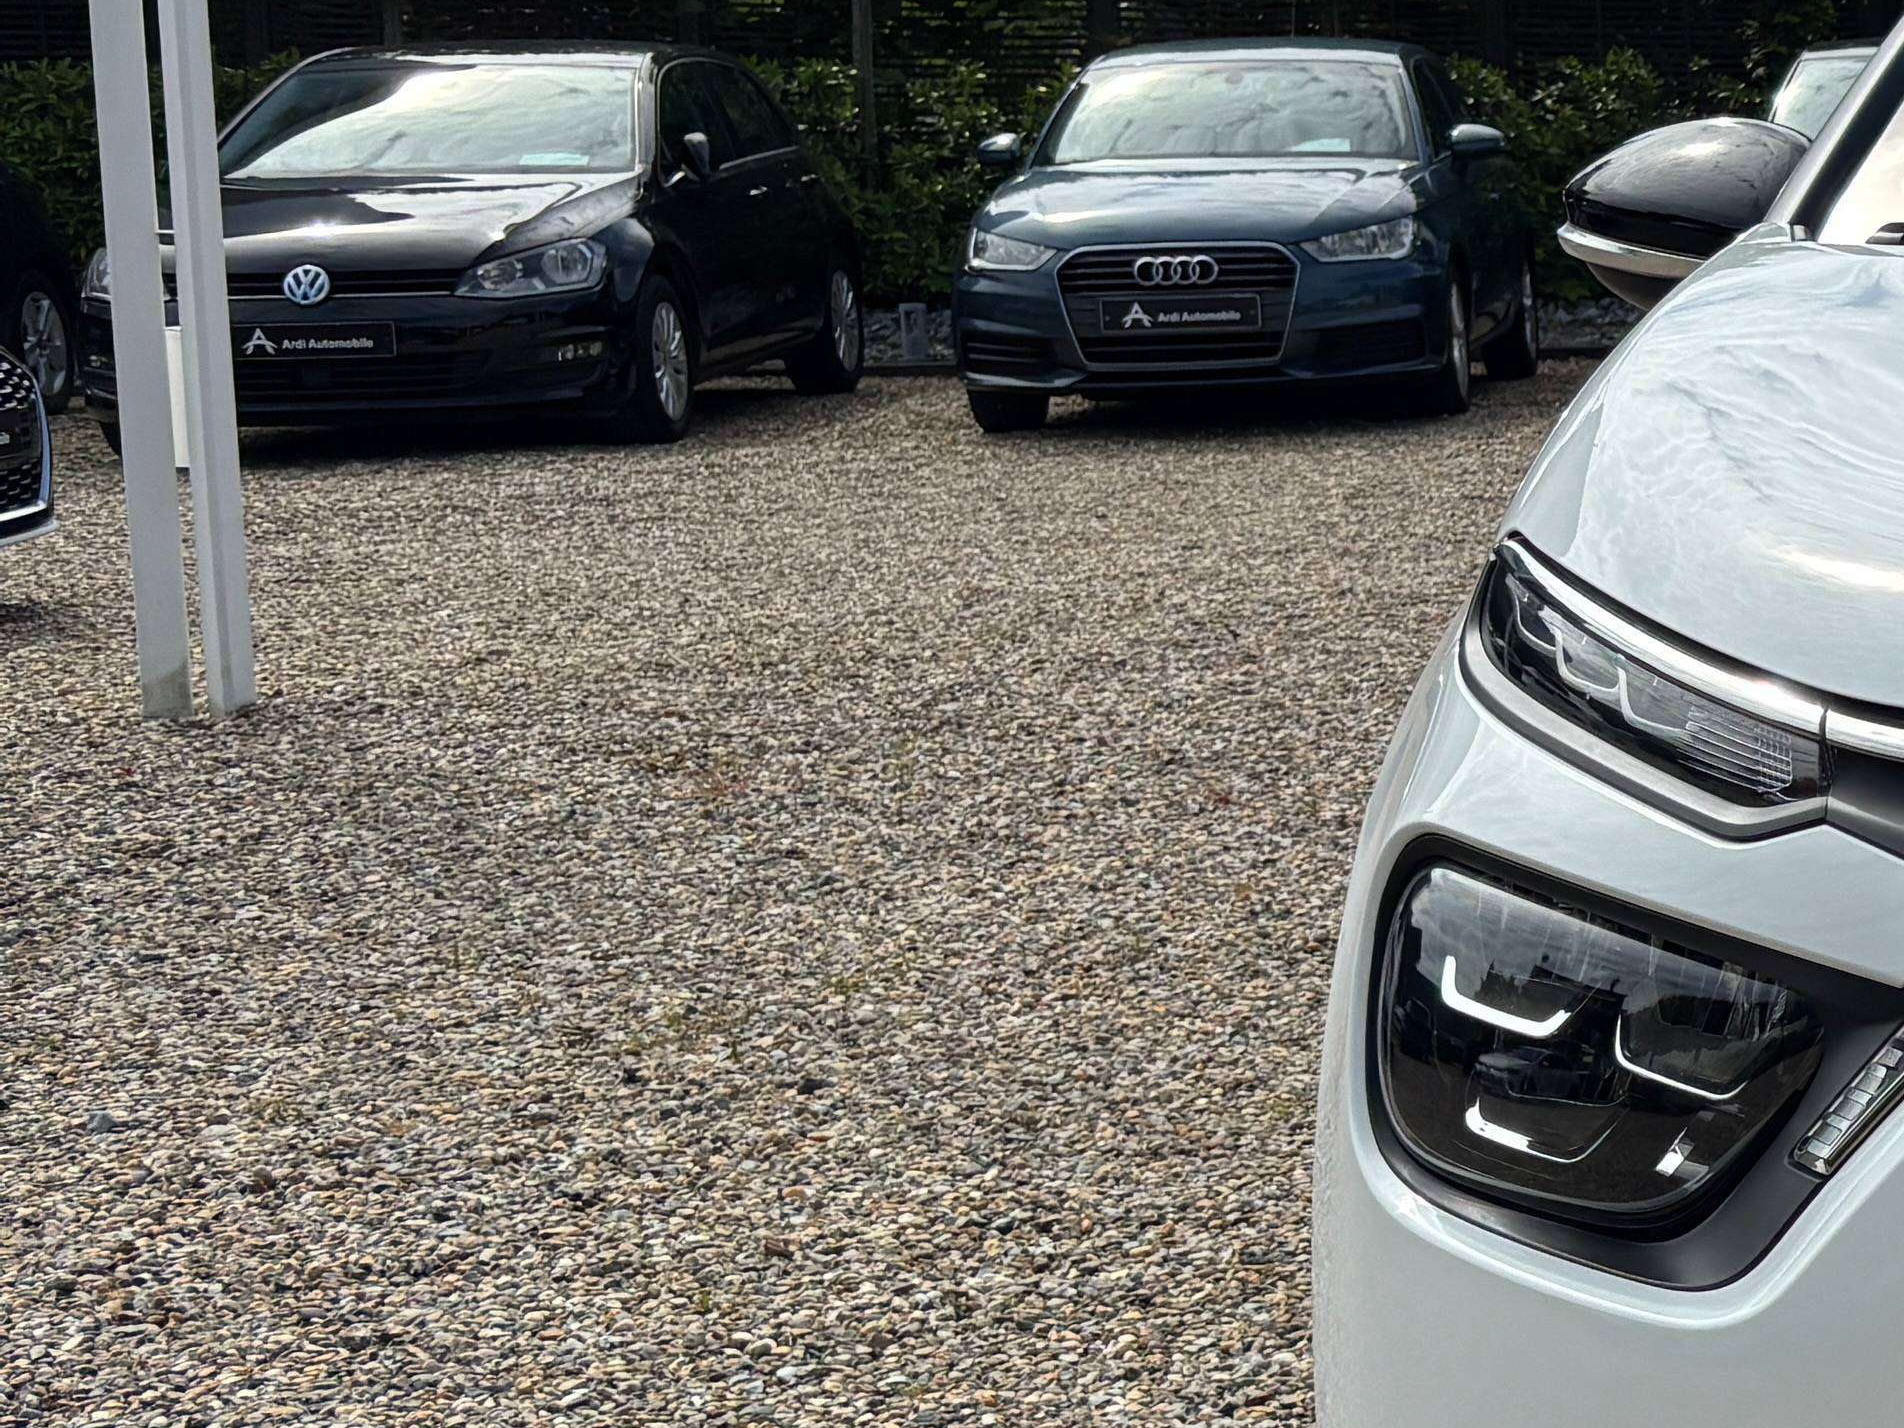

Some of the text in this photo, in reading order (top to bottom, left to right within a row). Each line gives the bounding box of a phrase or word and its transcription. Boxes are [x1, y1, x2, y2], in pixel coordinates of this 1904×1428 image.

[1157, 310, 1241, 322] Ardi Automobile
[282, 337, 373, 350] Ardi Automobile
